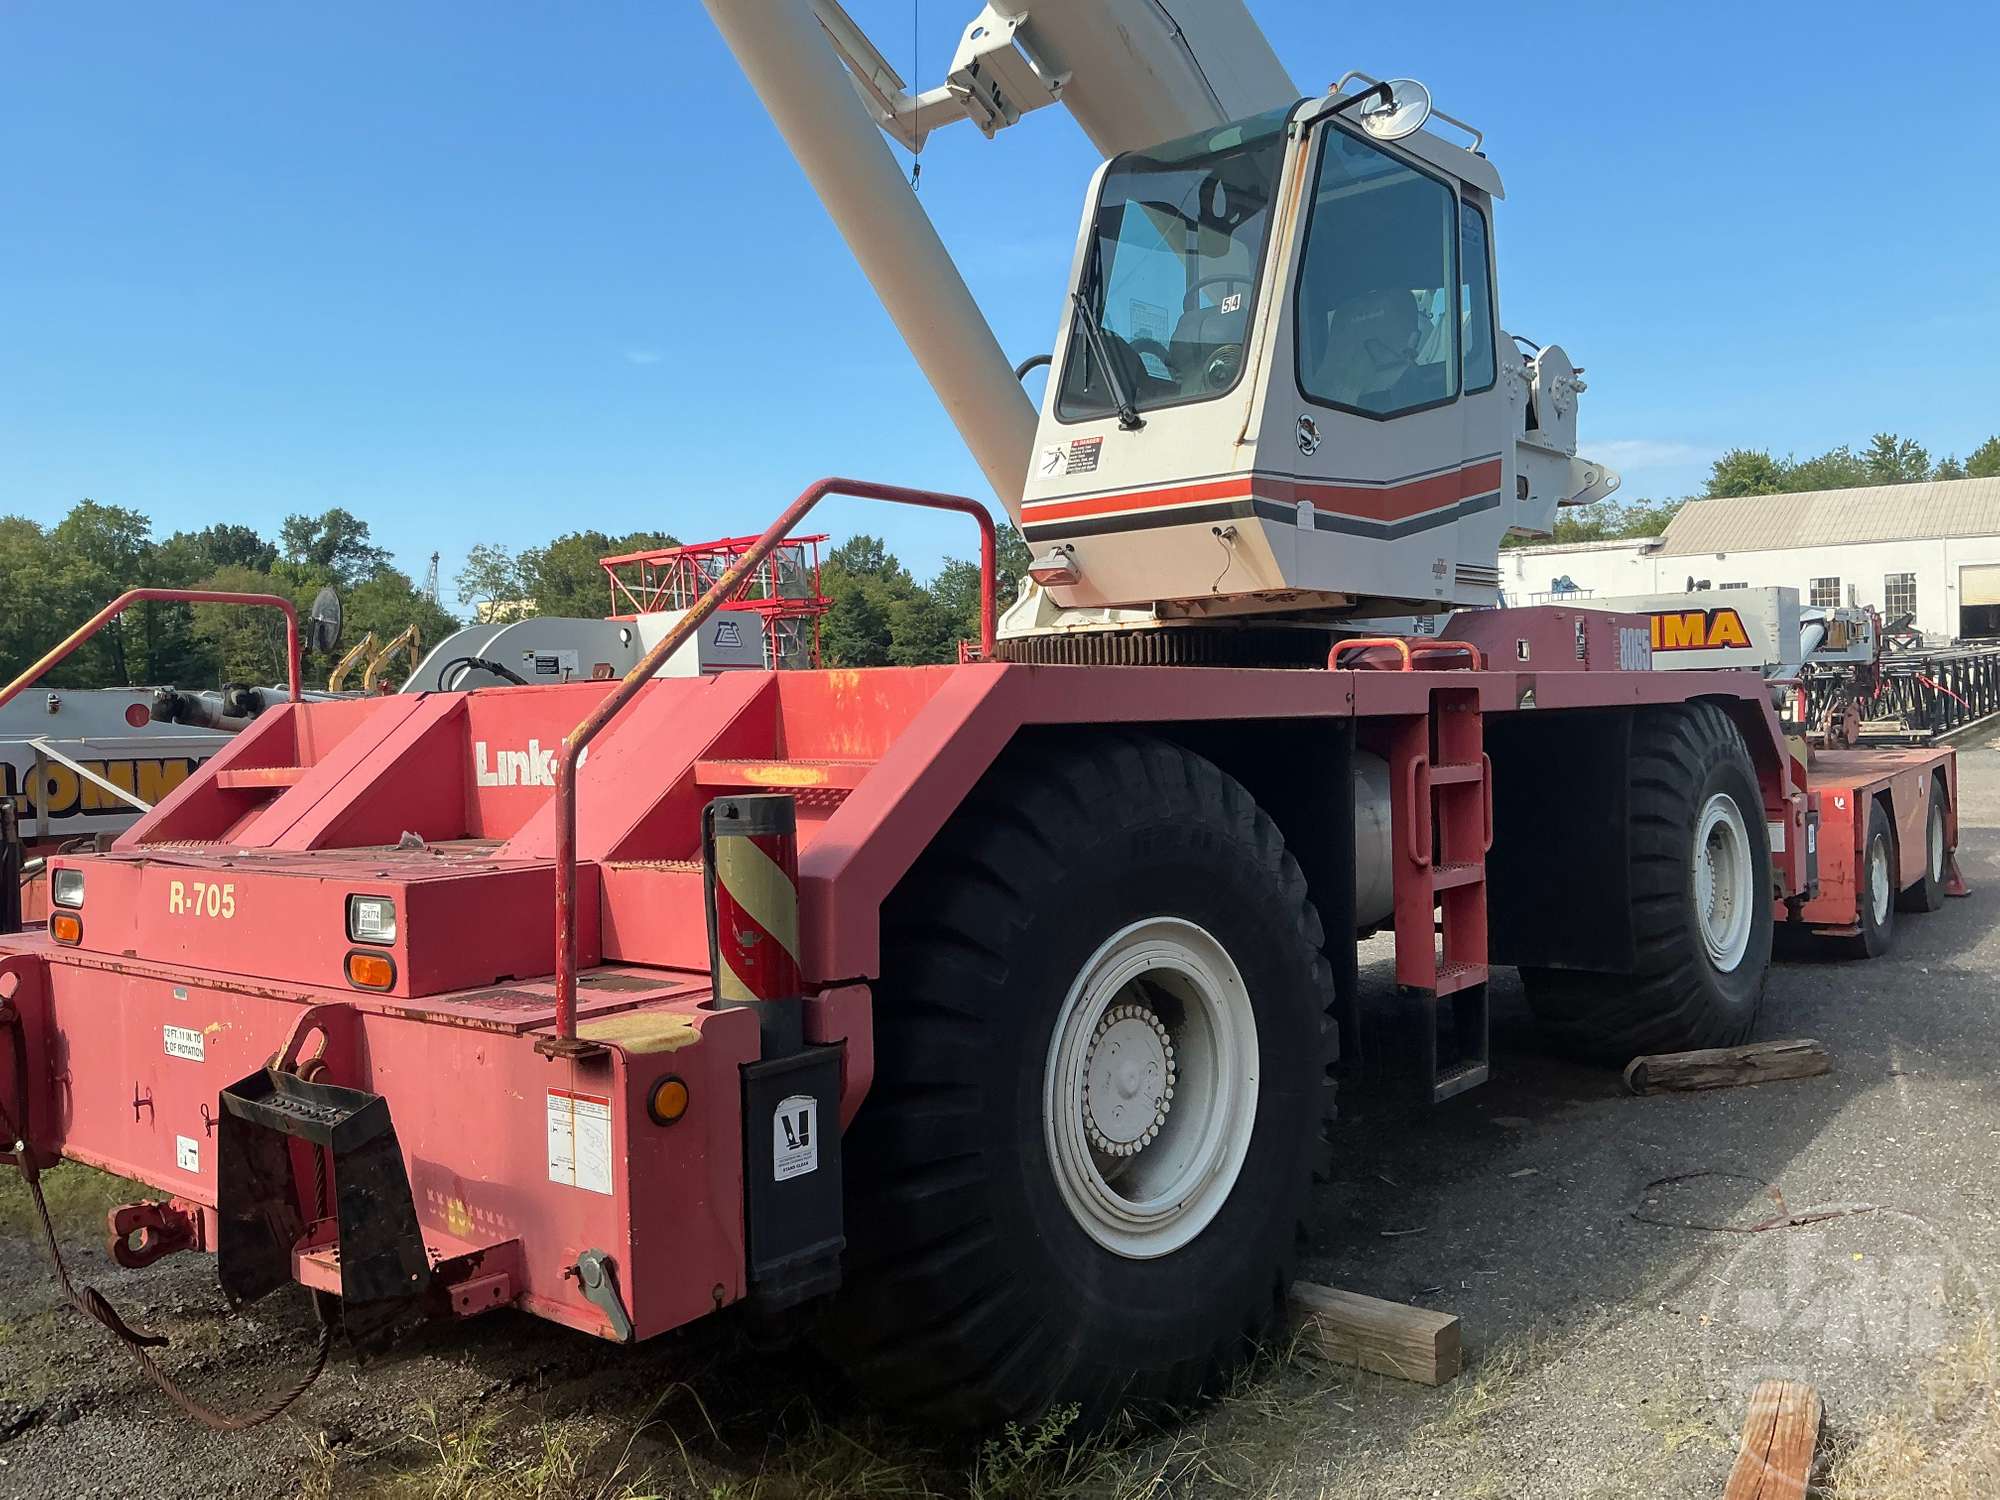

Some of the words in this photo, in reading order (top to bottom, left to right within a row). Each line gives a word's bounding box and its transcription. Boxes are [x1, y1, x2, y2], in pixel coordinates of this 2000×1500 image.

[1223, 296, 1239, 312] 54
[169, 880, 236, 919] R-705
[193, 1033, 202, 1044] TO
[170, 1041, 177, 1052] OF
[177, 1044, 204, 1058] ROTATION
